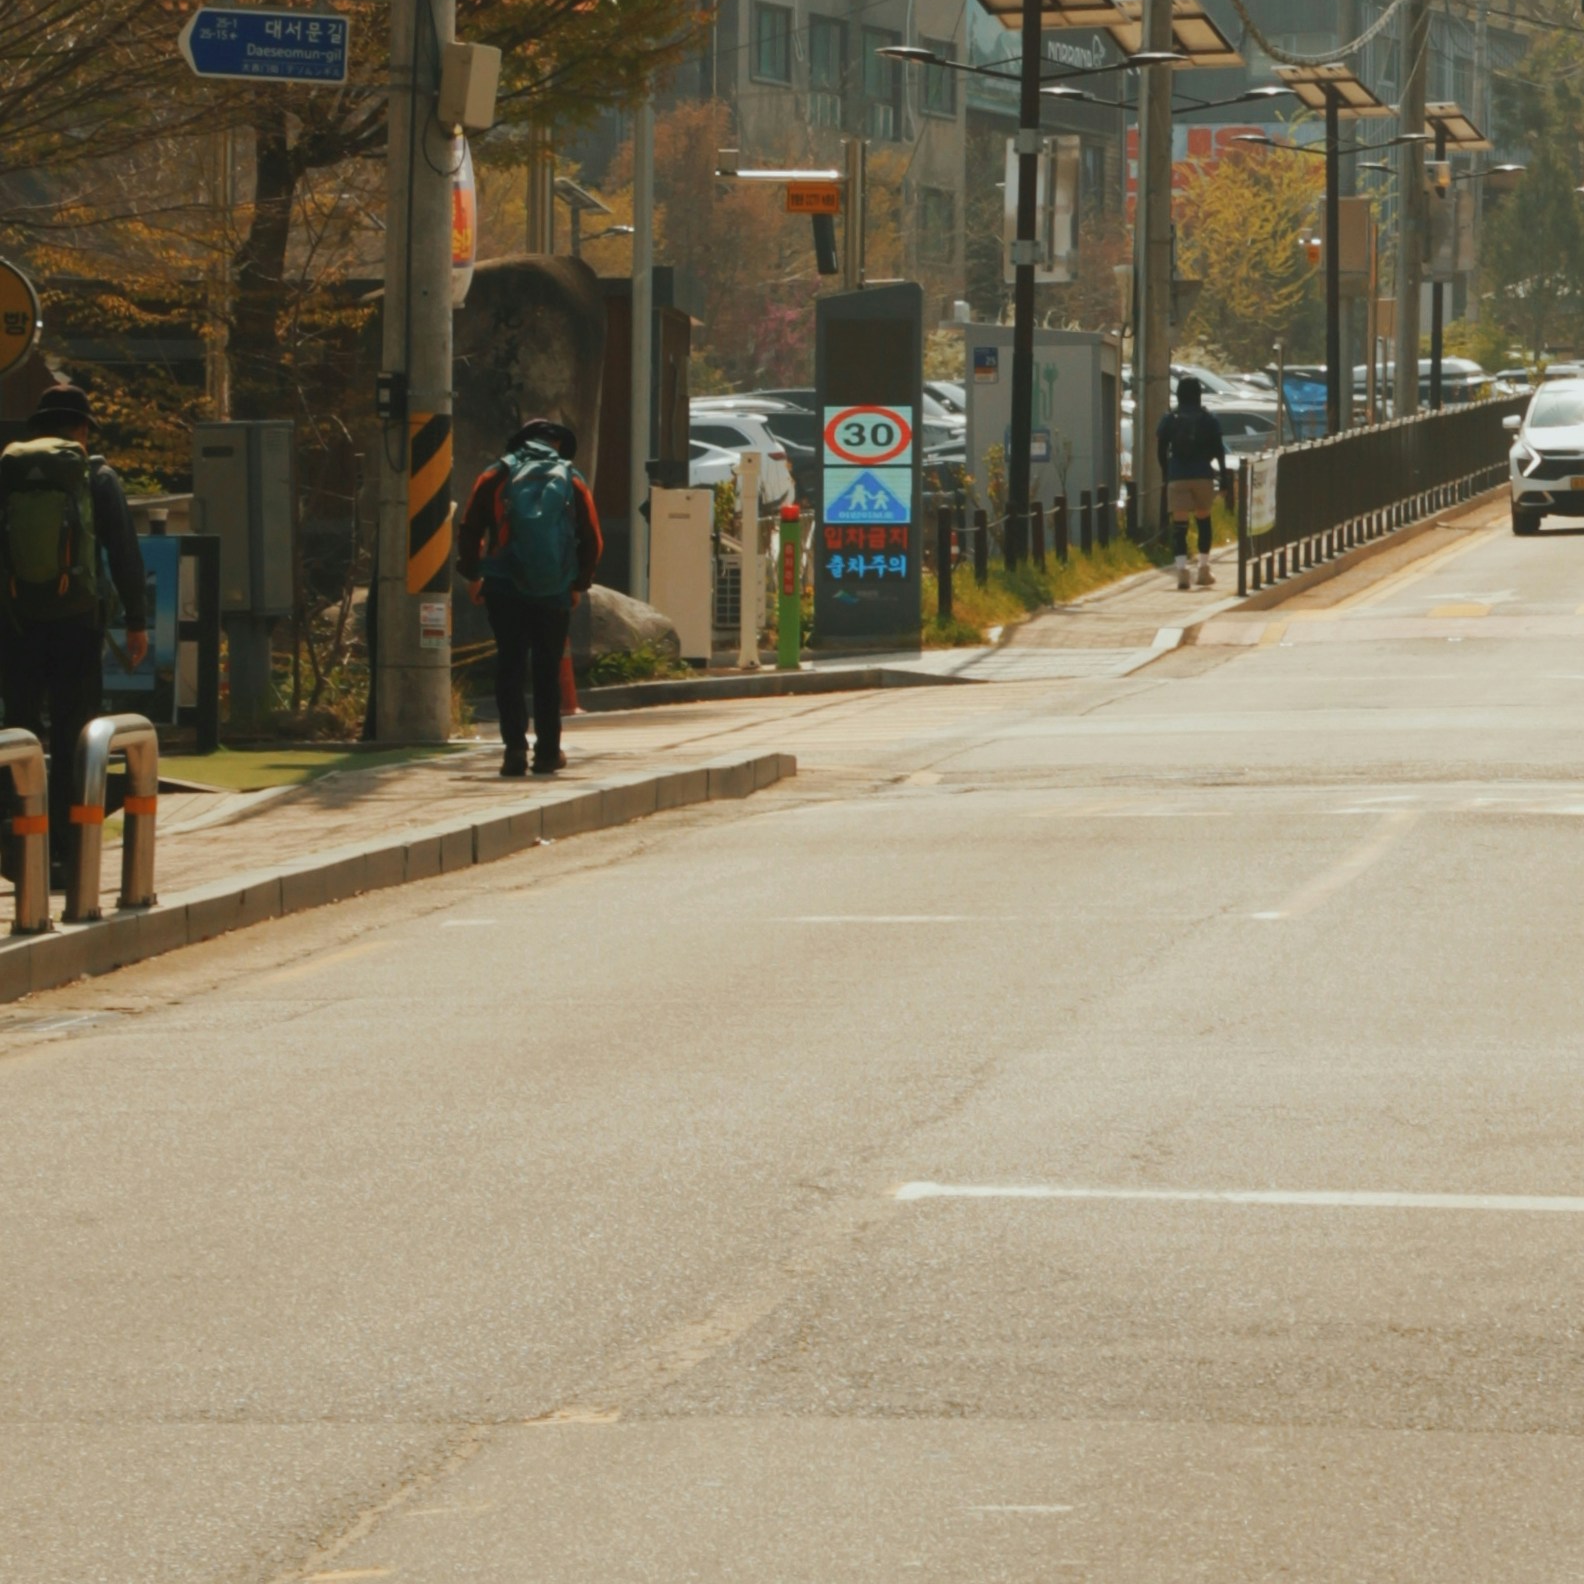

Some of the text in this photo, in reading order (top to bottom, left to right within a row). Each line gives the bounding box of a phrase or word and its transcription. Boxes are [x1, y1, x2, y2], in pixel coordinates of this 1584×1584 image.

[264, 18, 343, 45] 대서문길
[246, 43, 343, 63] Daeseomun-gil
[843, 422, 894, 447] 30
[825, 528, 908, 549] 입차금지
[826, 554, 907, 578] 출차주의
